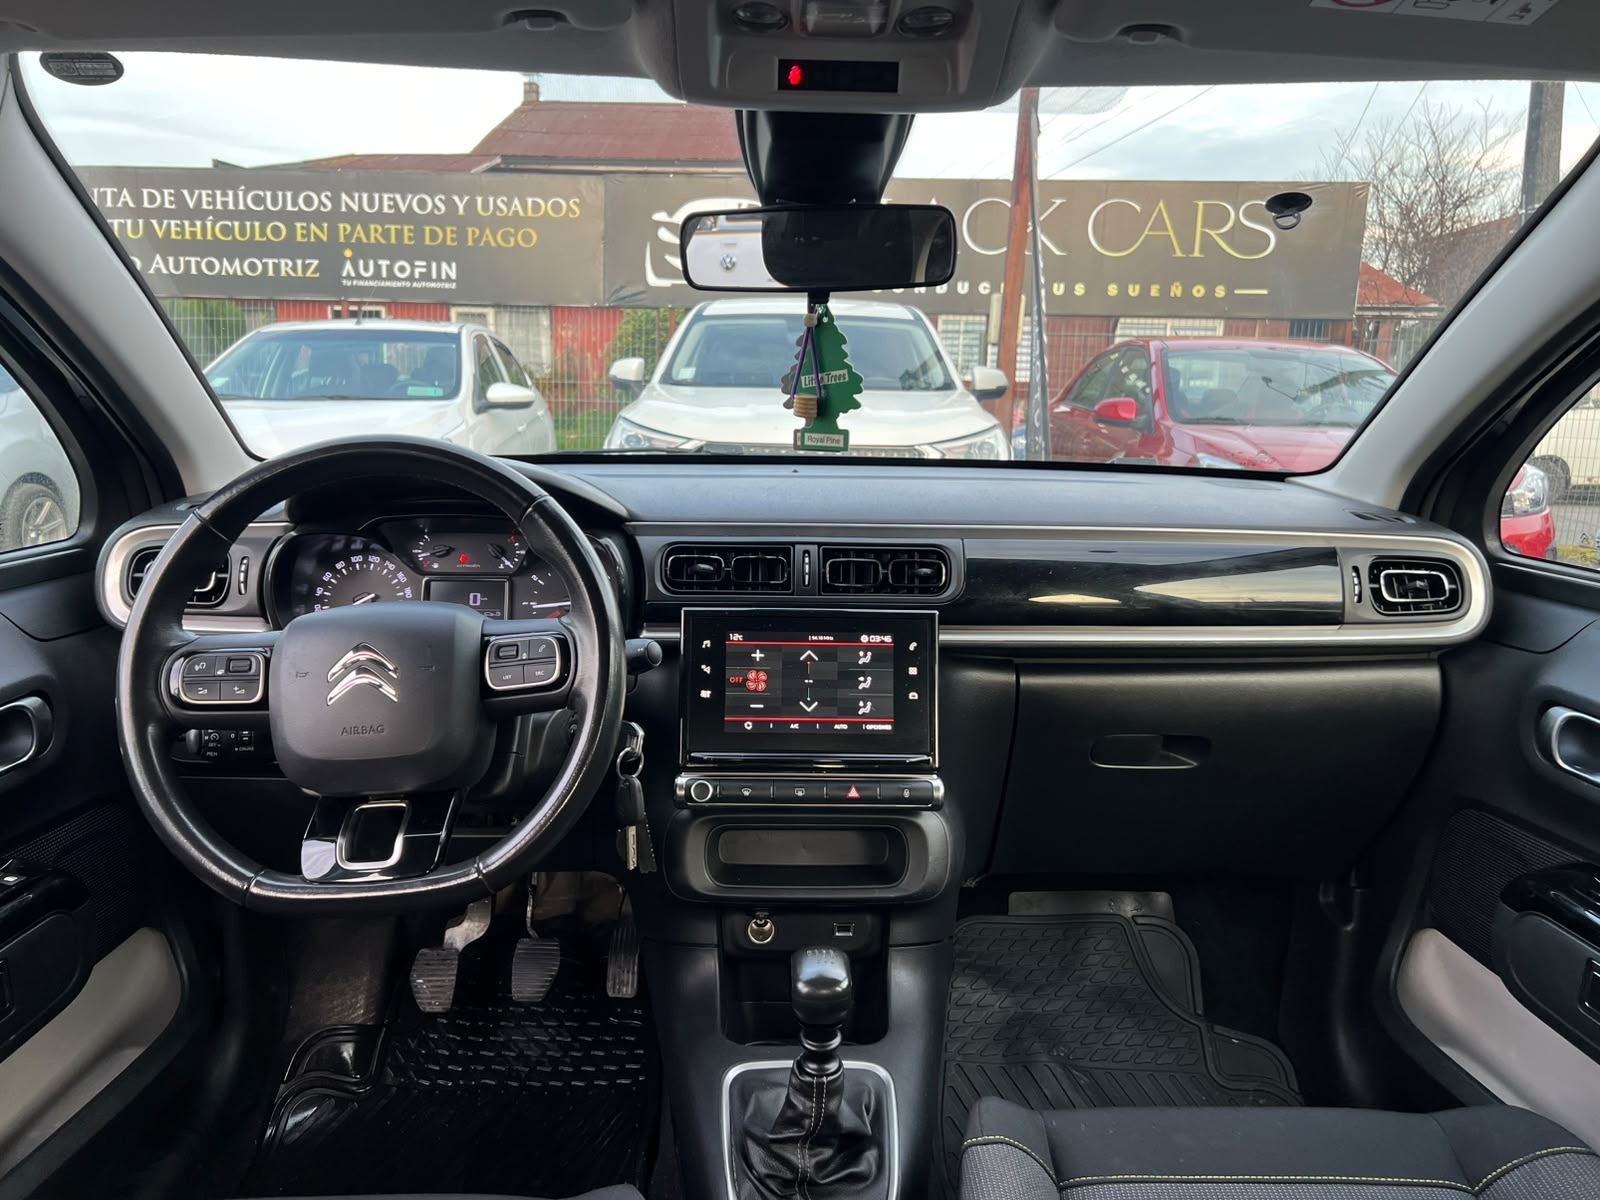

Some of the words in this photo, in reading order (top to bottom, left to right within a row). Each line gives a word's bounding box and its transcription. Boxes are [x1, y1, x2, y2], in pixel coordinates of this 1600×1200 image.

[141, 188, 176, 209] DE
[181, 185, 332, 212] VEHÍCULOS
[340, 192, 446, 215] NUEVOS
[450, 195, 471, 216] Y
[475, 196, 581, 218] USADOS
[107, 218, 144, 240] TU
[149, 216, 287, 242] VEHÍCULO
[295, 222, 328, 242] EN
[337, 223, 415, 245] PARTE
[423, 225, 458, 246] DE
[466, 227, 538, 248] PAGO
[1087, 198, 1276, 260] CARS
[148, 253, 320, 278] AUTOMOTRIZ
[341, 258, 457, 280] AUTOFIN
[1107, 280, 1227, 298] SUEÑOS
[824, 371, 847, 384] Trees
[807, 435, 825, 446] Royal
[826, 436, 841, 446] Pine
[368, 555, 380, 563] 120
[469, 592, 481, 606] 0
[869, 635, 892, 643] 03:46
[729, 676, 743, 684] OFF
[340, 725, 385, 736] AIRBAG
